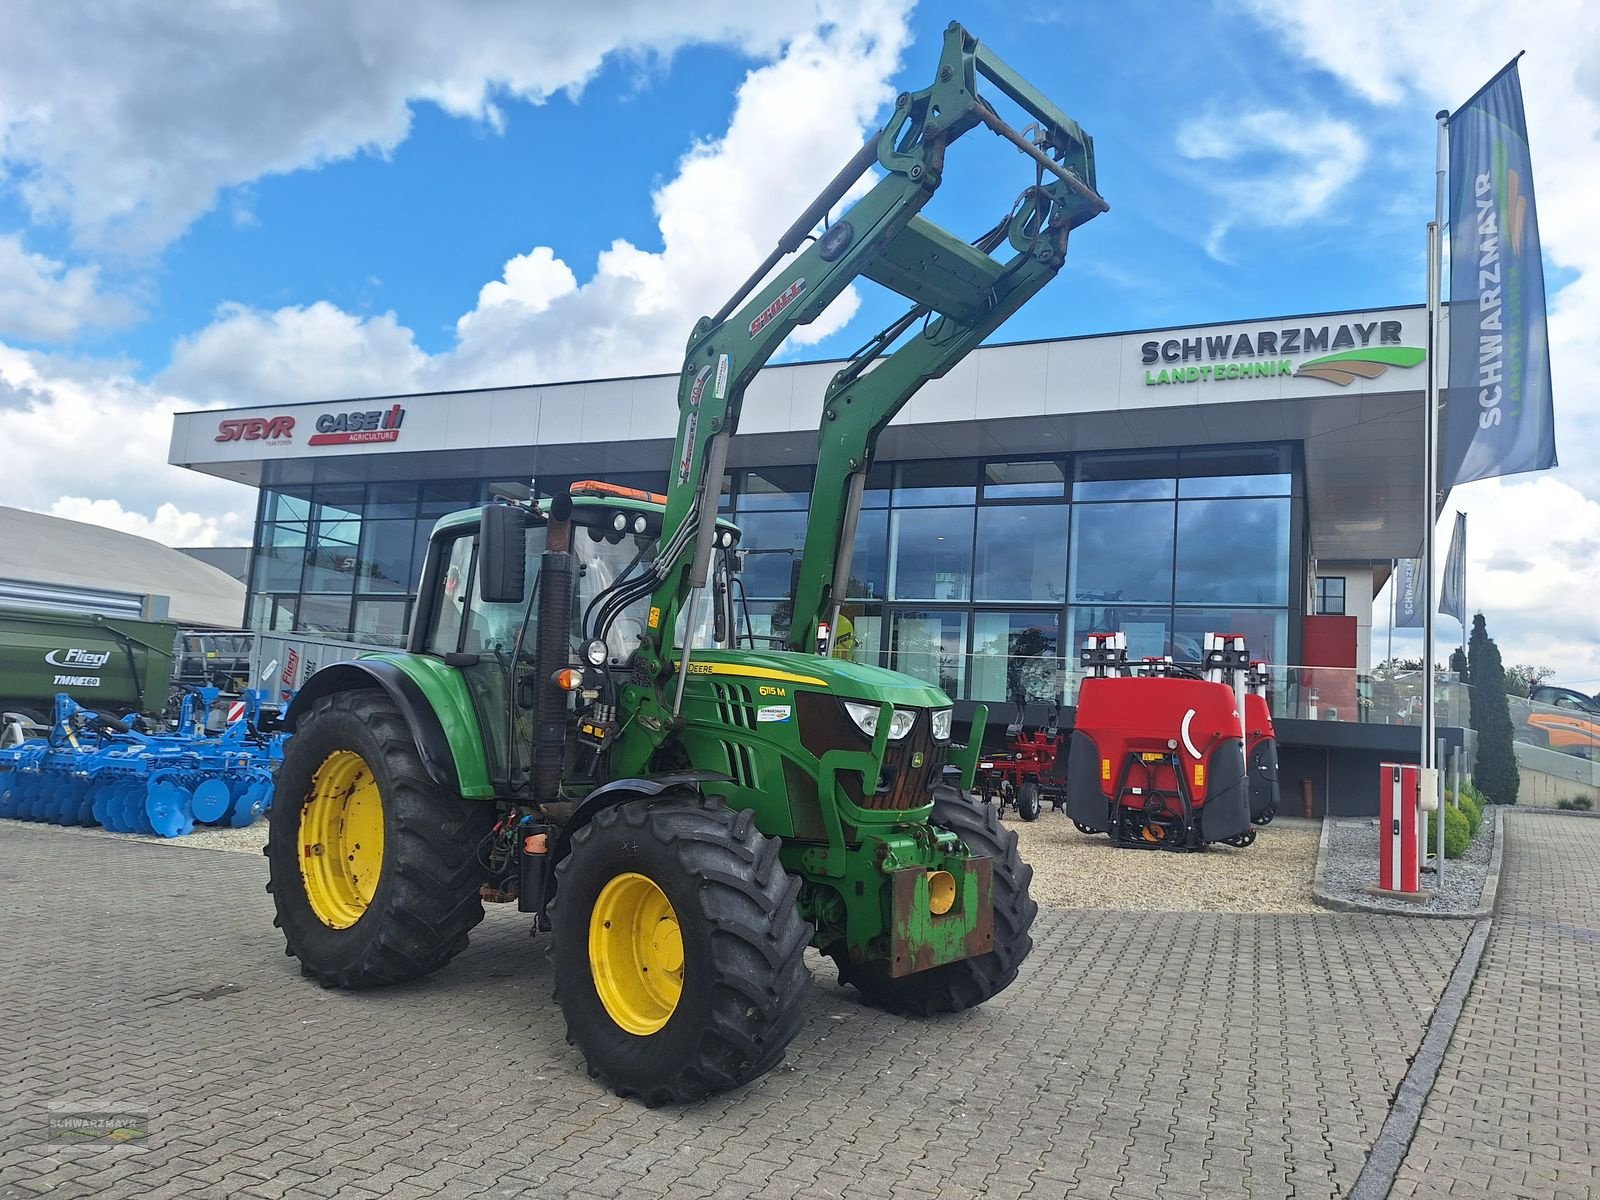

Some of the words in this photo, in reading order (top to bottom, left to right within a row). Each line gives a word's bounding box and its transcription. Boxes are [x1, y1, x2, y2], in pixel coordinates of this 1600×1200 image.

[751, 282, 801, 336] STOLL
[1475, 169, 1504, 430] SCHWARZMAYR
[1141, 320, 1402, 364] SCHWARZMAYR
[1145, 359, 1293, 385] LANDTECHNIK
[215, 416, 295, 441] STEYR
[316, 411, 382, 433] CASE
[348, 431, 395, 441] AGRICULTURE
[65, 648, 111, 666] Fliegl
[282, 647, 299, 685] Fliegl
[689, 663, 714, 673] DEERE
